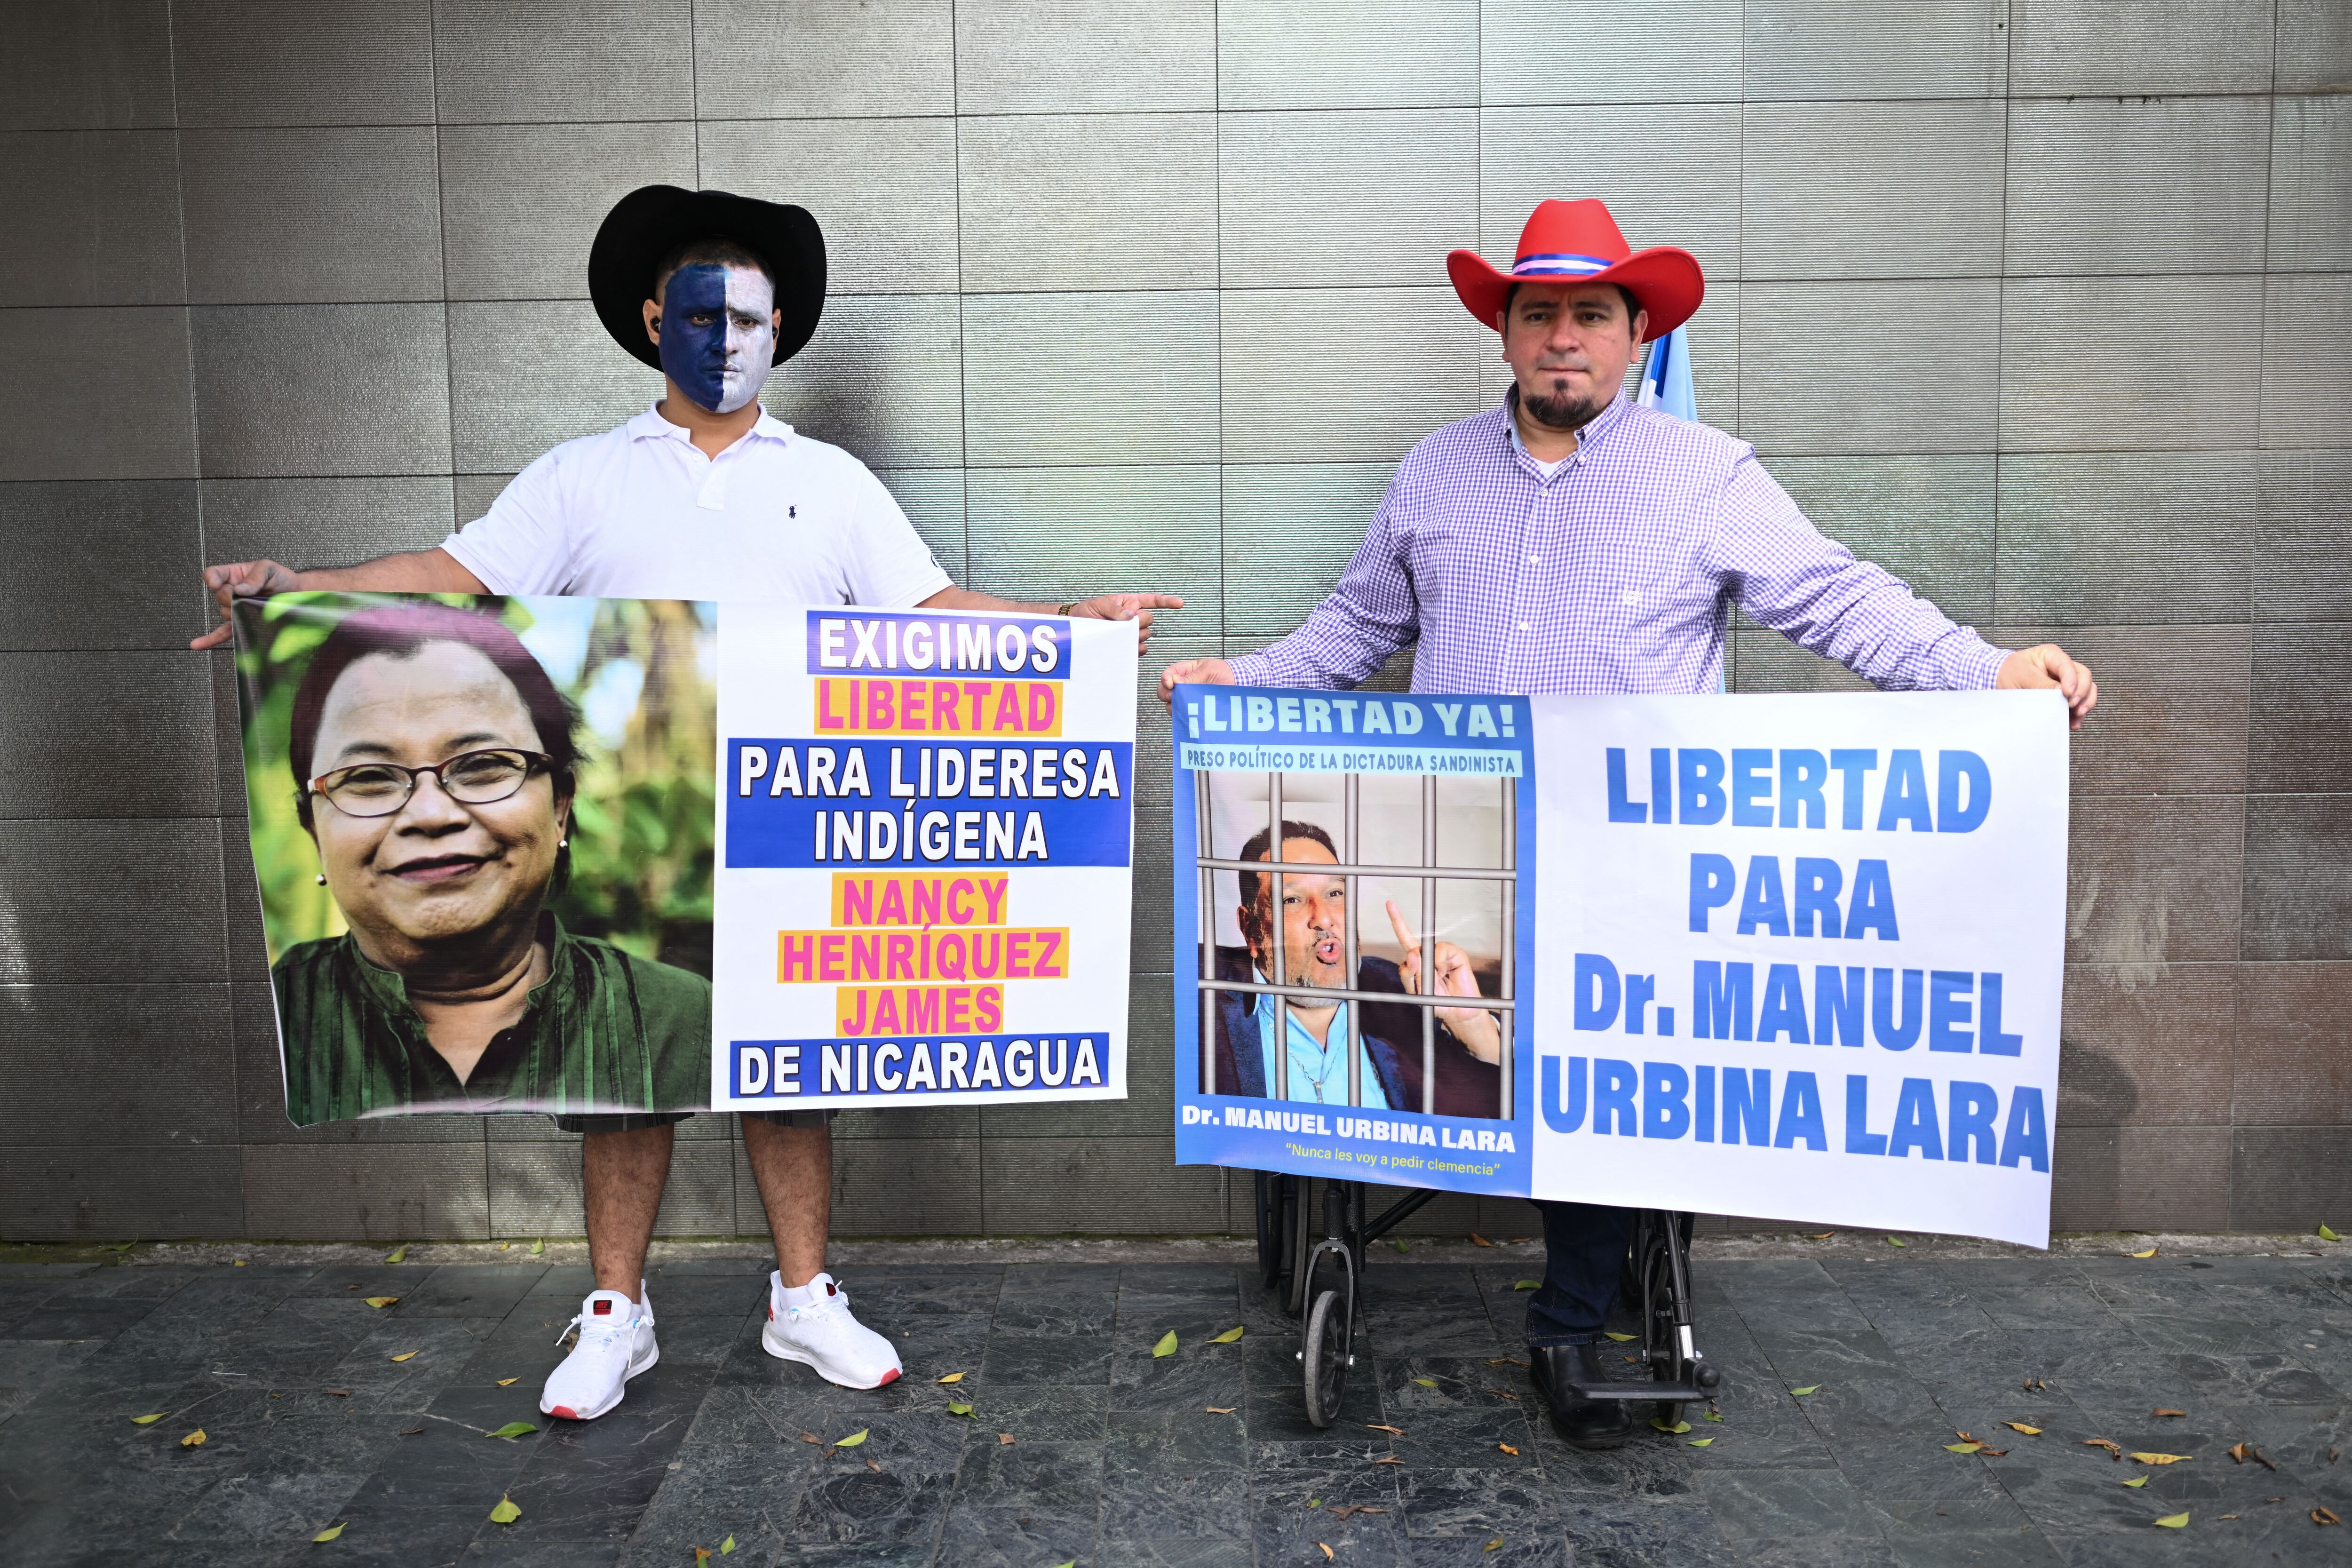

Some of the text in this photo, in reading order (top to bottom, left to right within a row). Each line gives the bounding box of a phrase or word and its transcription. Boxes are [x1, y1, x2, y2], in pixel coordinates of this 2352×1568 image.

[819, 618, 1059, 673] EXIGIMOS
[819, 680, 1055, 732] LIBERTAD
[1188, 695, 1515, 739] ¡LIBERTAD YA!
[739, 745, 1120, 799] PARA LIDERESA
[1188, 745, 1515, 773] PRESO POLÍTICO DE LA DICTADURA SANDINISTA
[1605, 747, 1992, 833] LIBERTAD
[814, 798, 1049, 861] INDÍGENA
[844, 878, 1009, 925] NANCY
[1689, 852, 1900, 941] PARA
[783, 923, 1062, 983] HENRÍQUEZ
[842, 987, 1001, 1036] JAMES
[1573, 952, 2024, 1057] Dr. MANUEL
[739, 1039, 1102, 1095] DE NICARAGUA
[1182, 1105, 1516, 1153] Dr. MANUEL URBINA LARA
[1541, 1054, 2050, 1173] URBINA LARA
[1286, 1143, 1501, 1176] “Nunca les voy a pedir clemencia”
